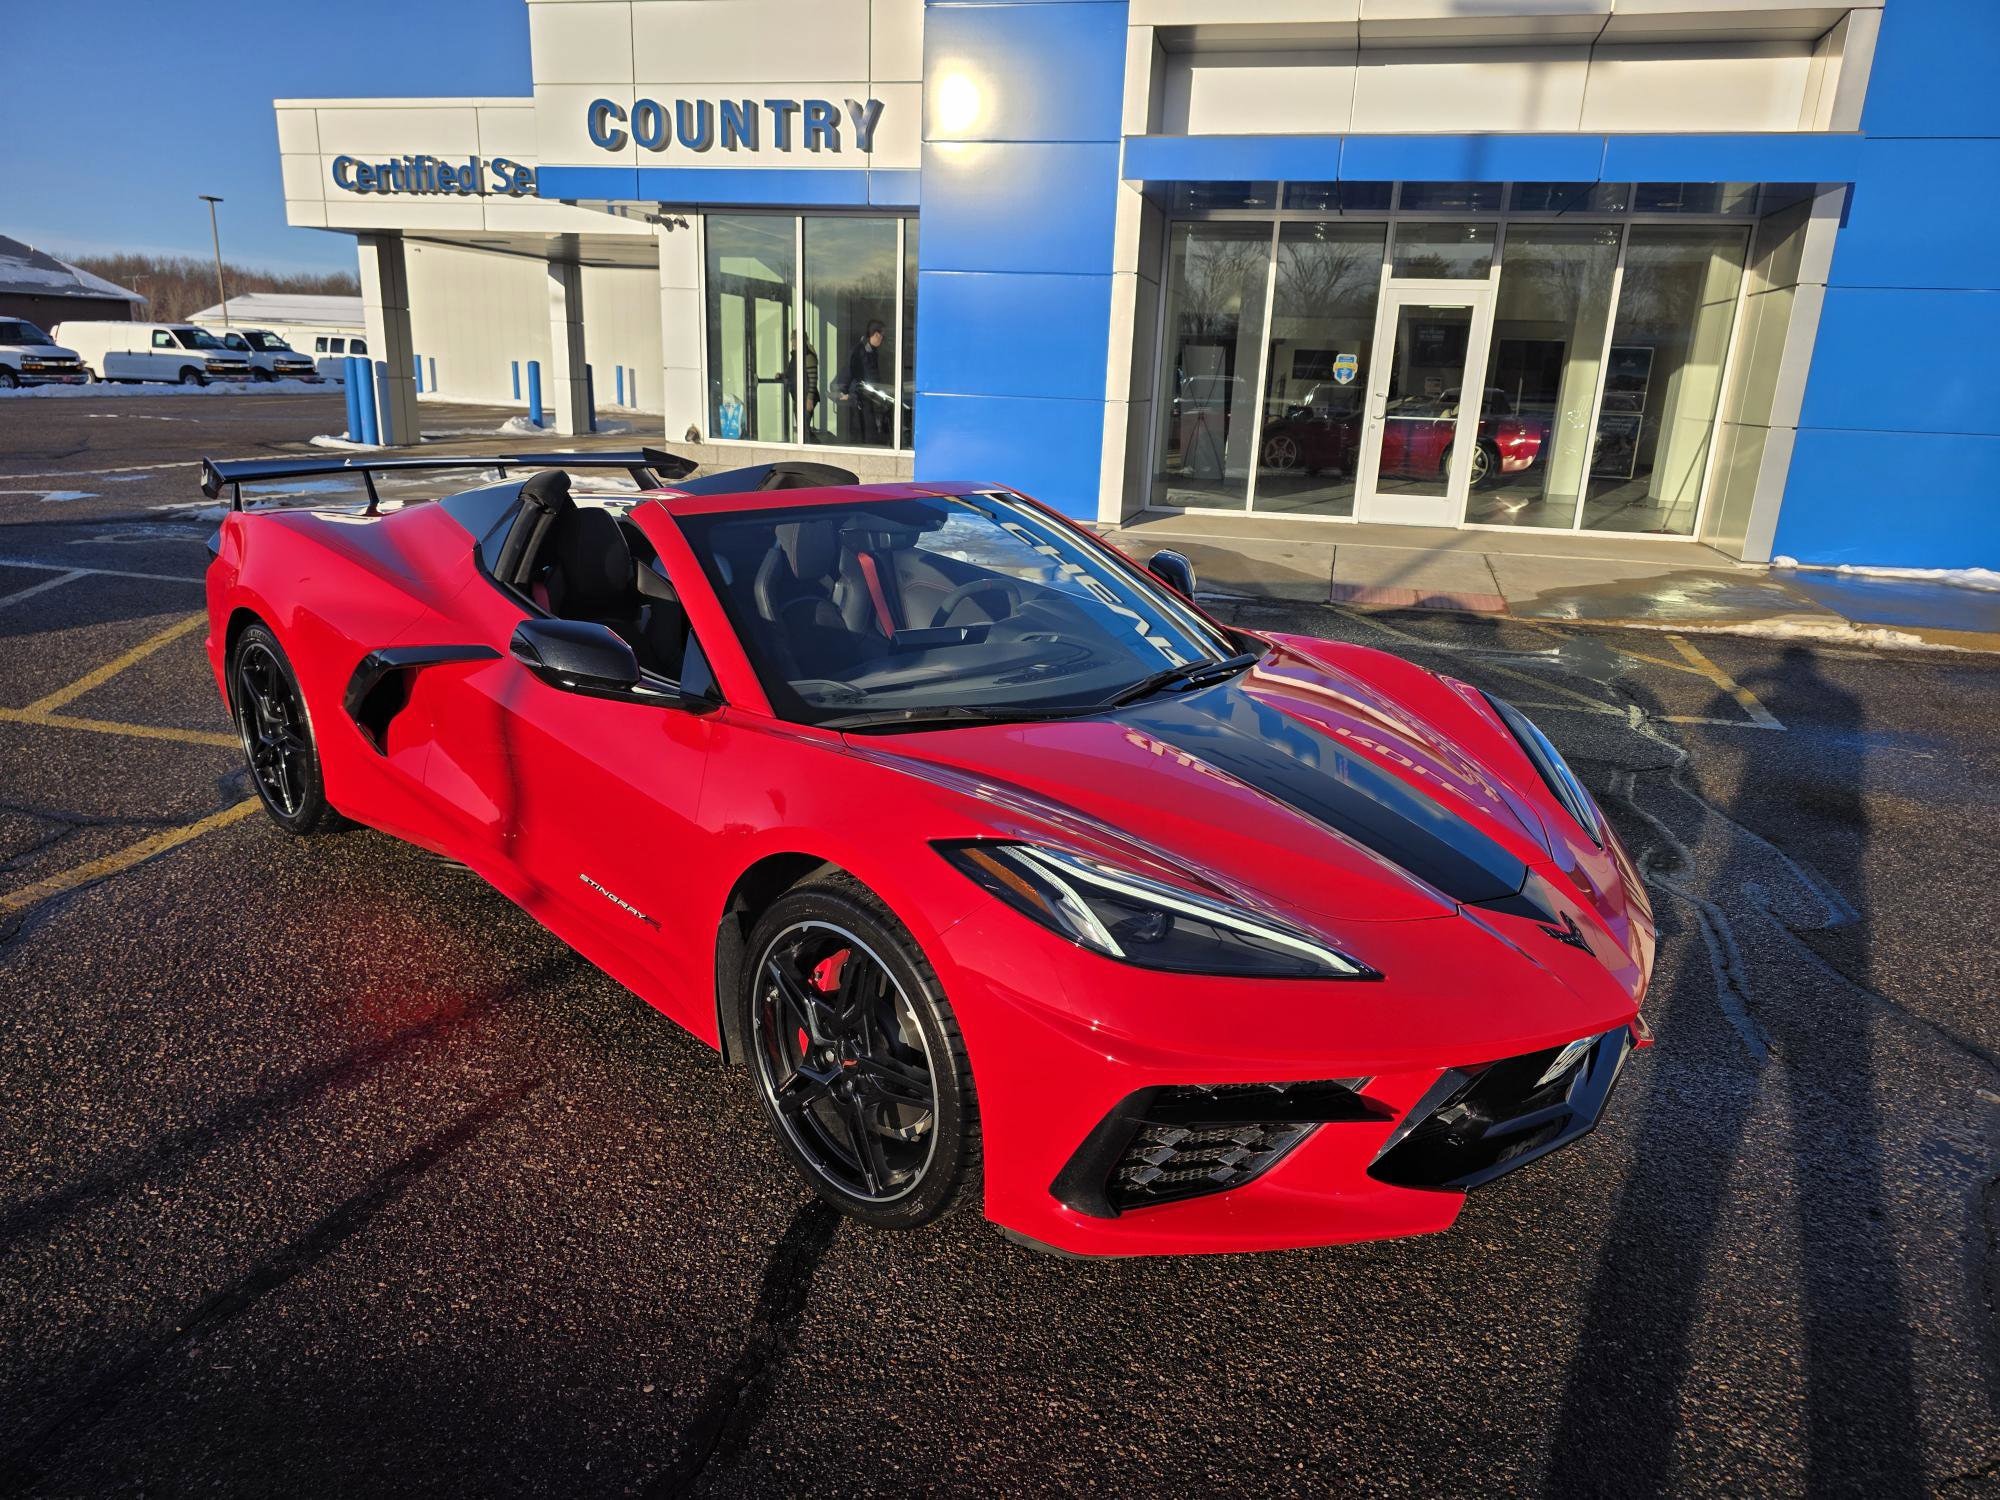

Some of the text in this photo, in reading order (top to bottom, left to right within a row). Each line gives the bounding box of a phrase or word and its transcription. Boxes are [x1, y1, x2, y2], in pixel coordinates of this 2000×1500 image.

[588, 97, 884, 152] COUNTRY
[332, 154, 536, 194] Certified Se
[579, 873, 647, 918] STINGRAY
